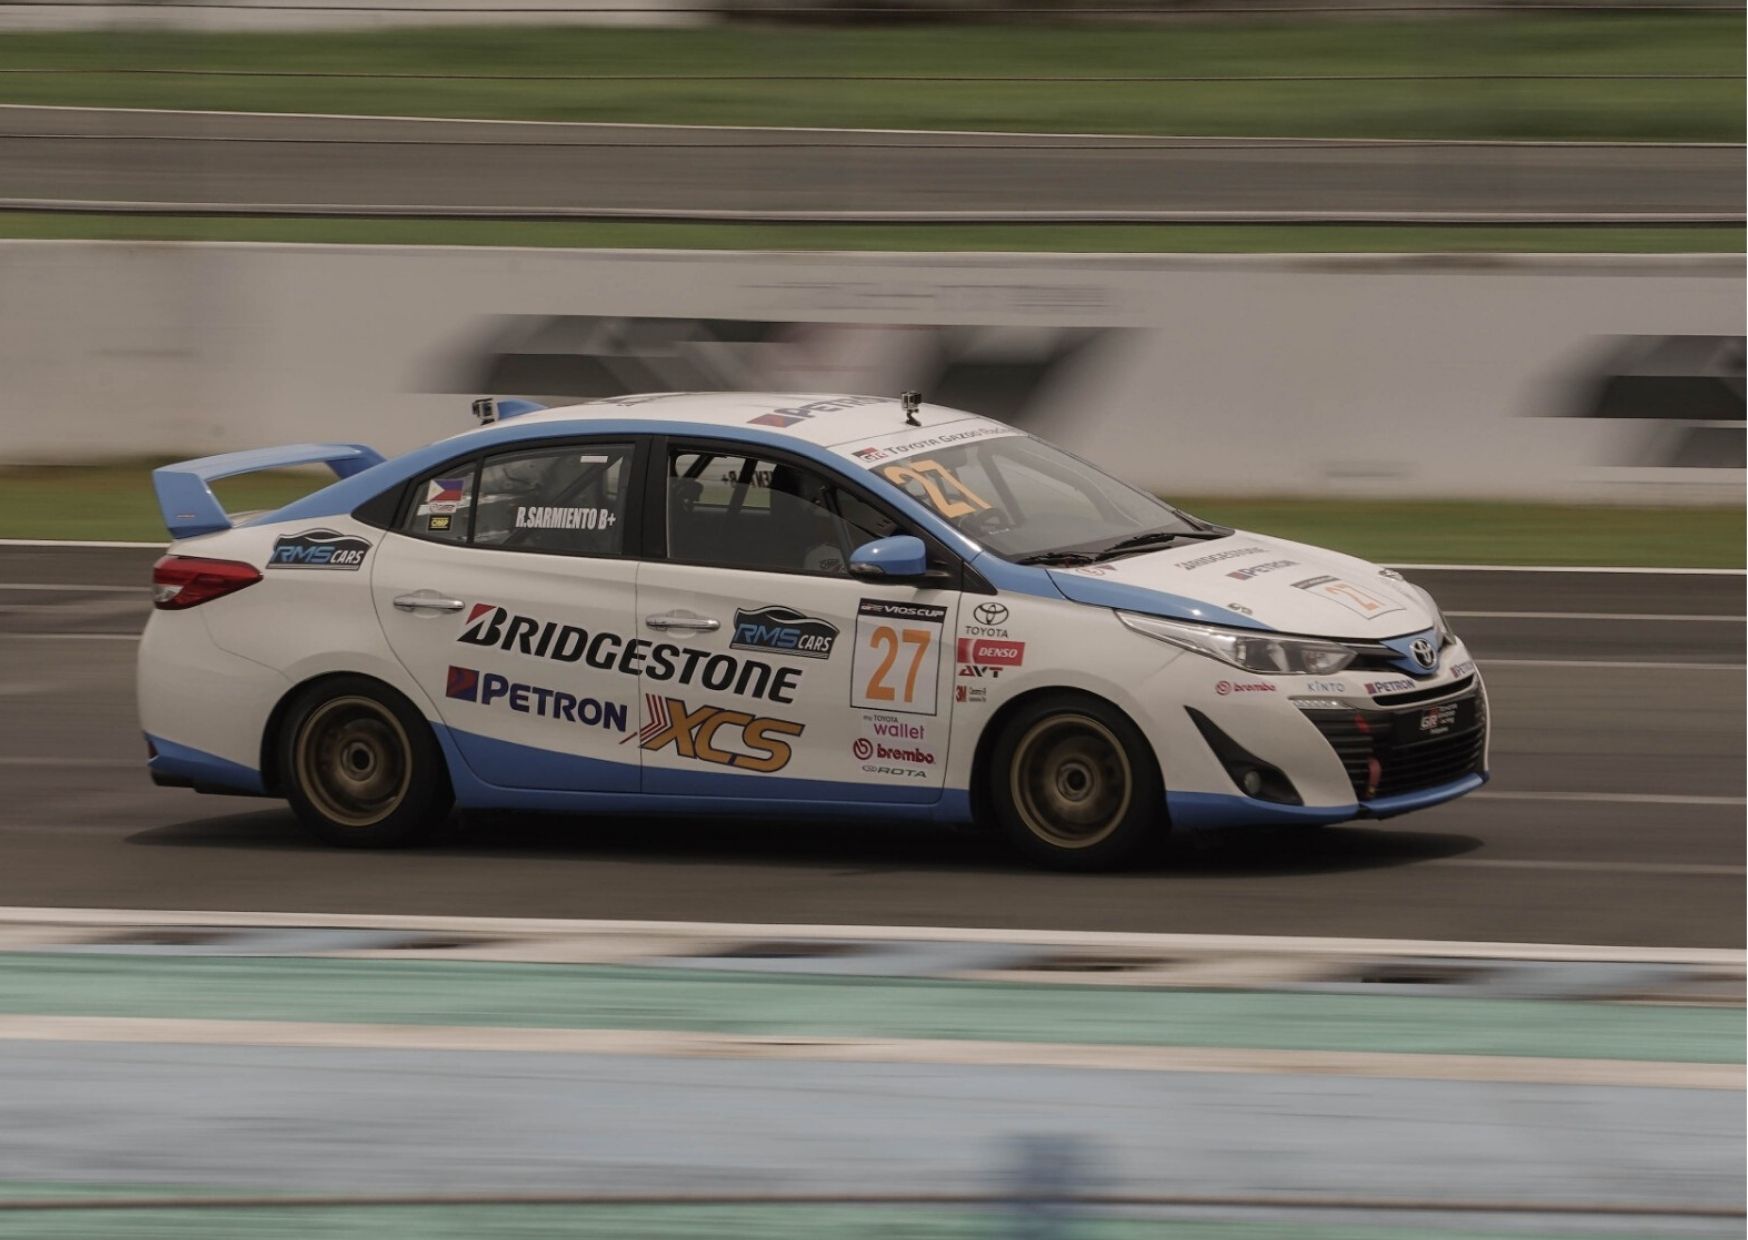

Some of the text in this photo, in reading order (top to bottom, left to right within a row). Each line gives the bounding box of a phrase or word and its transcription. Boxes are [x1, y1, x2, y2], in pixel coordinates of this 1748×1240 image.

[884, 438, 940, 455] TOYOTA
[884, 459, 992, 518] 27
[515, 507, 617, 529] R.SARMIENTO B+
[272, 545, 364, 564] RMS CARS
[735, 623, 832, 652] RMS CARS
[965, 625, 1009, 639] TOYOTA
[457, 602, 804, 704] BRIDGESTONE
[978, 647, 1018, 658] DENSO
[865, 626, 932, 703] 27
[959, 665, 1003, 678] AVT
[1375, 680, 1416, 693] PETRON
[480, 672, 629, 733] PETRON
[873, 714, 898, 723] TOYOTA
[638, 696, 806, 774] XCS
[874, 723, 925, 739] wallet
[877, 743, 935, 764] brembo
[877, 766, 927, 778] ROTA
